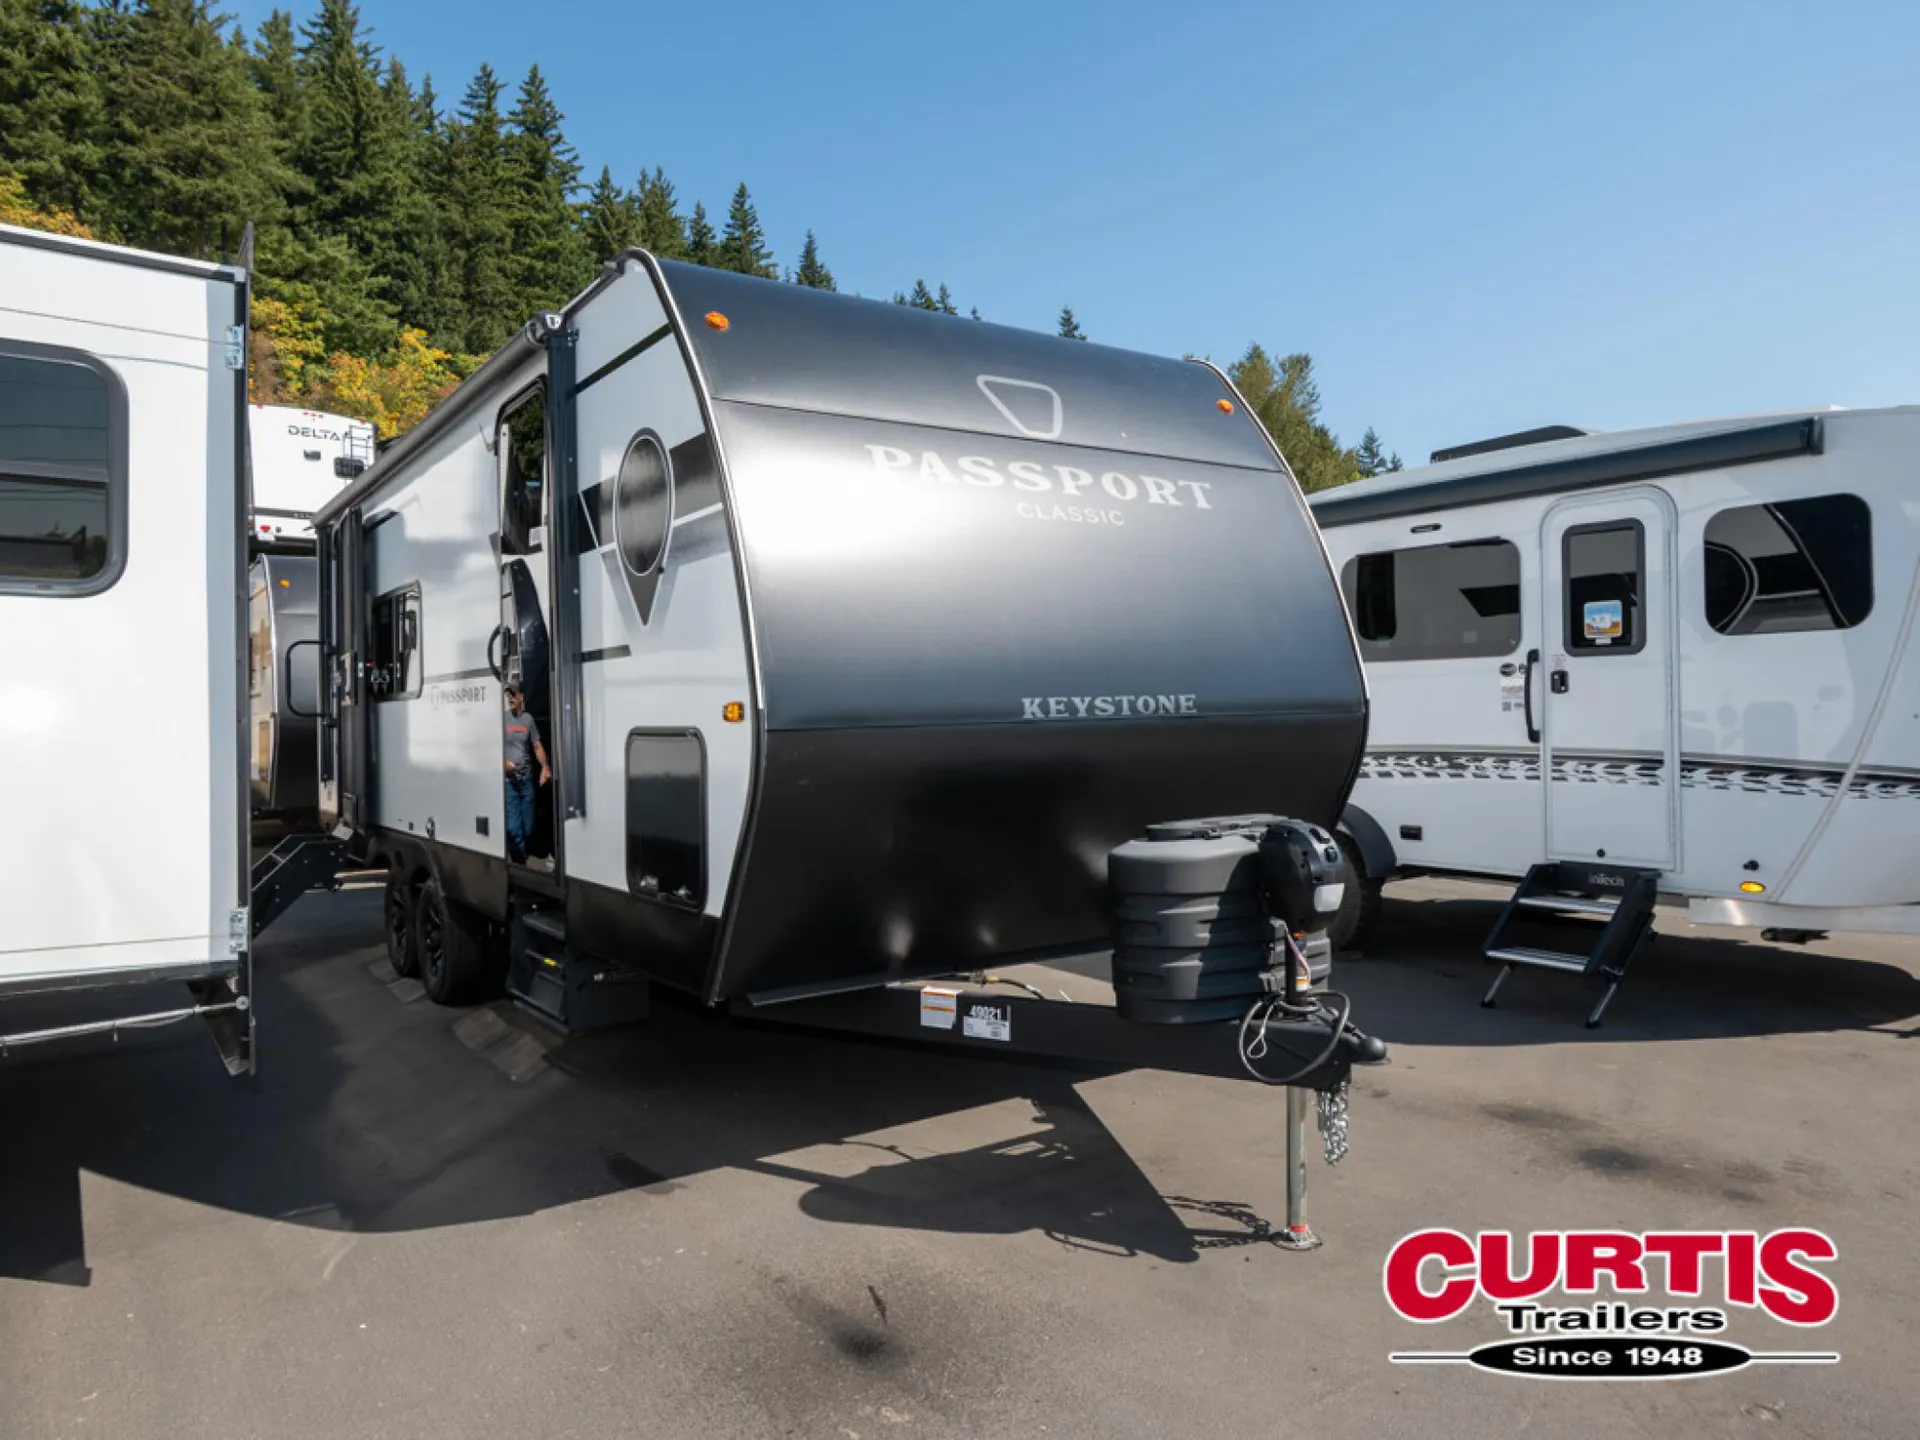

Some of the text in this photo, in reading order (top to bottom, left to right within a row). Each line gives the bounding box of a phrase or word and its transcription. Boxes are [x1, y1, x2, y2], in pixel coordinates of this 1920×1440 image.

[288, 425, 341, 441] DELTA
[864, 443, 1213, 509] PASSPORT
[1016, 500, 1125, 526] CLASSIC
[1021, 694, 1197, 719] KEYSTONE
